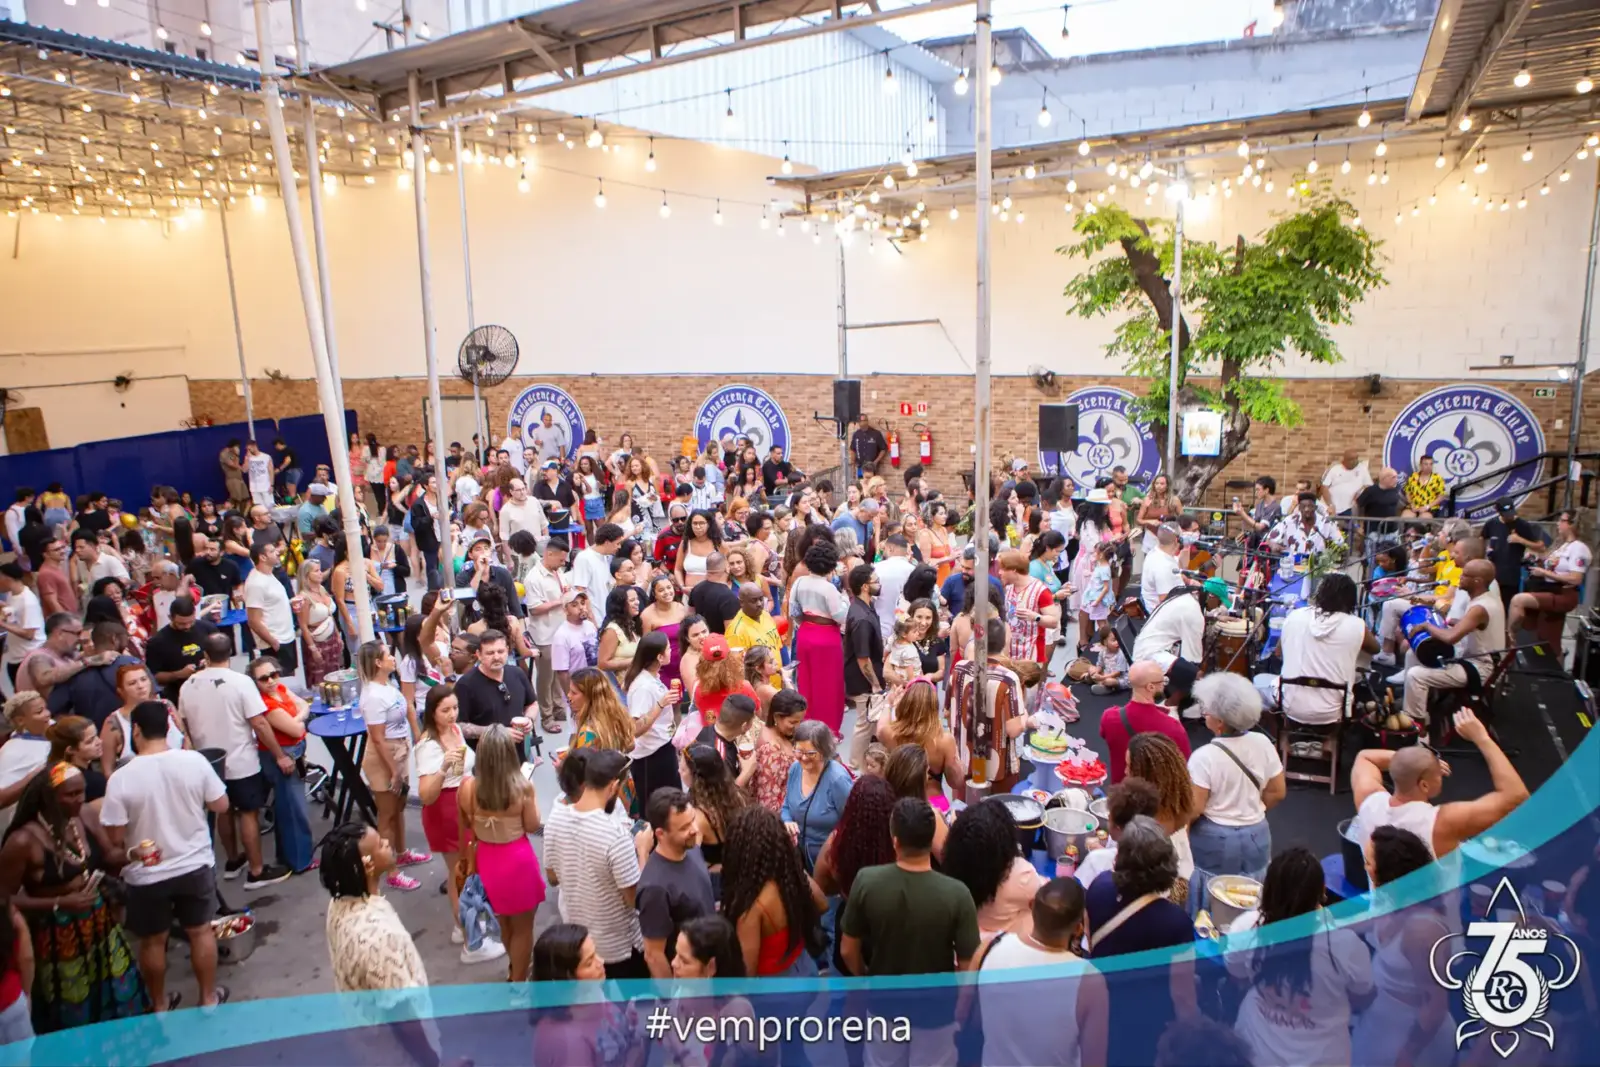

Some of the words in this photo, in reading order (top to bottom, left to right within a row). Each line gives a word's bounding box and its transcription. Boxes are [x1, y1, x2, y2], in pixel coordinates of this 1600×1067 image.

[557, 395, 578, 425] Clube
[700, 392, 754, 429] Renascença
[755, 397, 780, 429] Clube
[1396, 394, 1491, 441] Renascença
[1493, 400, 1530, 444] Clube
